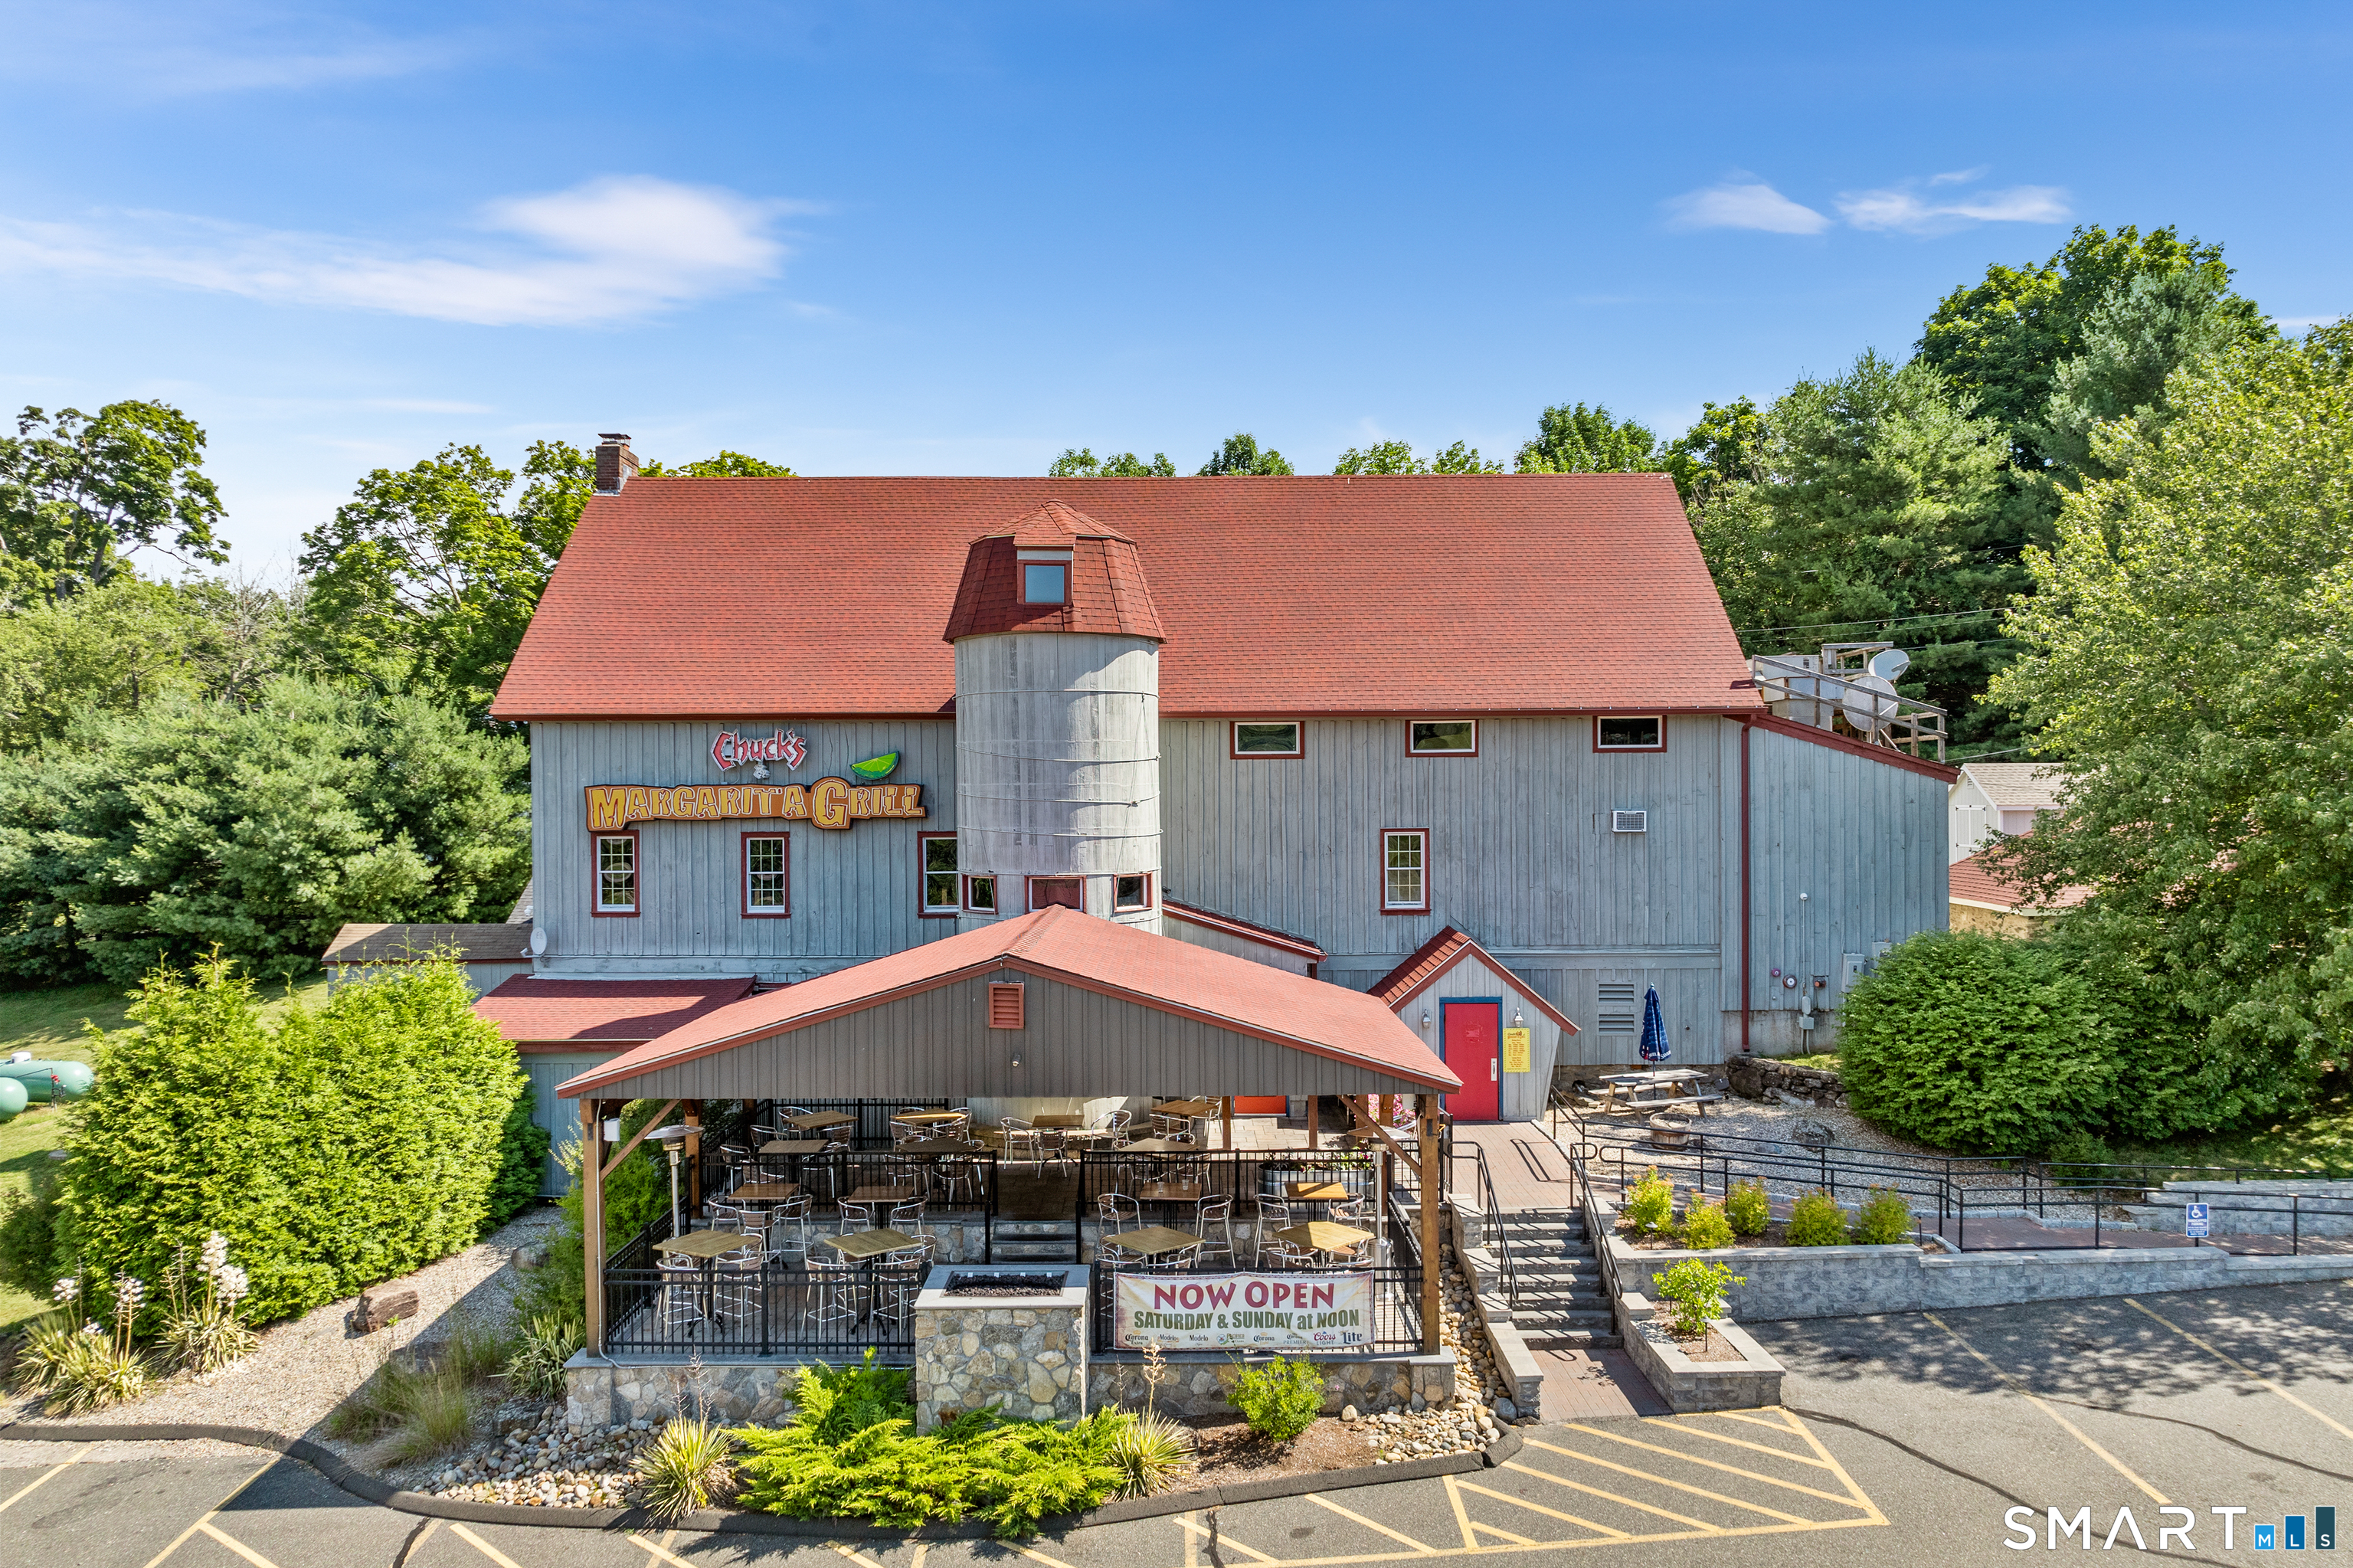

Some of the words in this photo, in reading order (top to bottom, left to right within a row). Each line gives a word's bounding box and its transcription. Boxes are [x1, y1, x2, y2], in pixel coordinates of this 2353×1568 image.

[712, 728, 807, 771] Chuck's
[590, 785, 807, 830] MARGARITA
[814, 779, 924, 828] GRILL
[1154, 1282, 1236, 1311] NOW
[1245, 1282, 1335, 1309] OPEN
[1134, 1311, 1214, 1330] SATURDAY
[1217, 1312, 1229, 1329] &
[1232, 1311, 1294, 1330] SUNDAY
[1298, 1313, 1314, 1330] at
[1317, 1309, 1360, 1328] NOON
[1314, 1332, 1336, 1340] Coors
[1343, 1332, 1362, 1344] Lite
